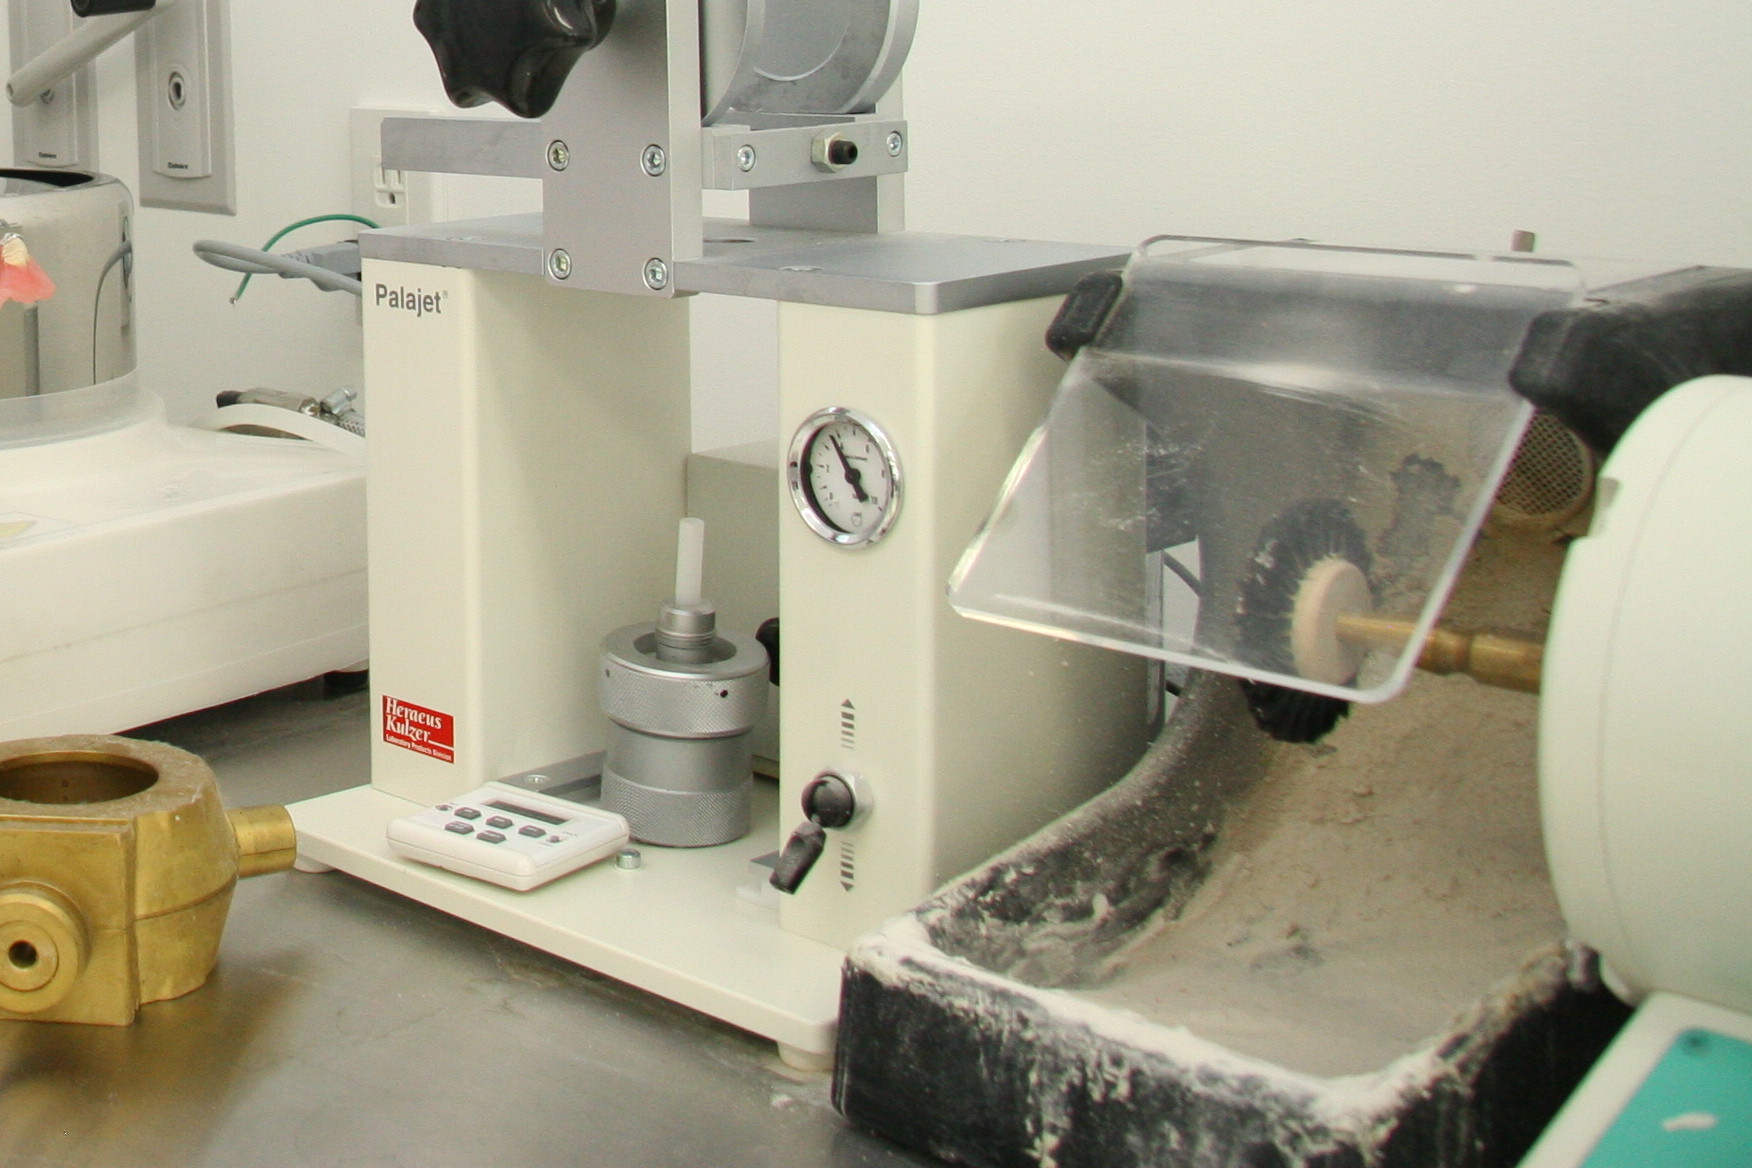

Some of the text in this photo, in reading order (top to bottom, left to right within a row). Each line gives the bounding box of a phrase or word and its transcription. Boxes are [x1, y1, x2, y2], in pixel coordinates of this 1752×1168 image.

[375, 284, 442, 317] Palajet
[386, 696, 442, 730] Heraeus
[386, 713, 431, 743] Kulzer
